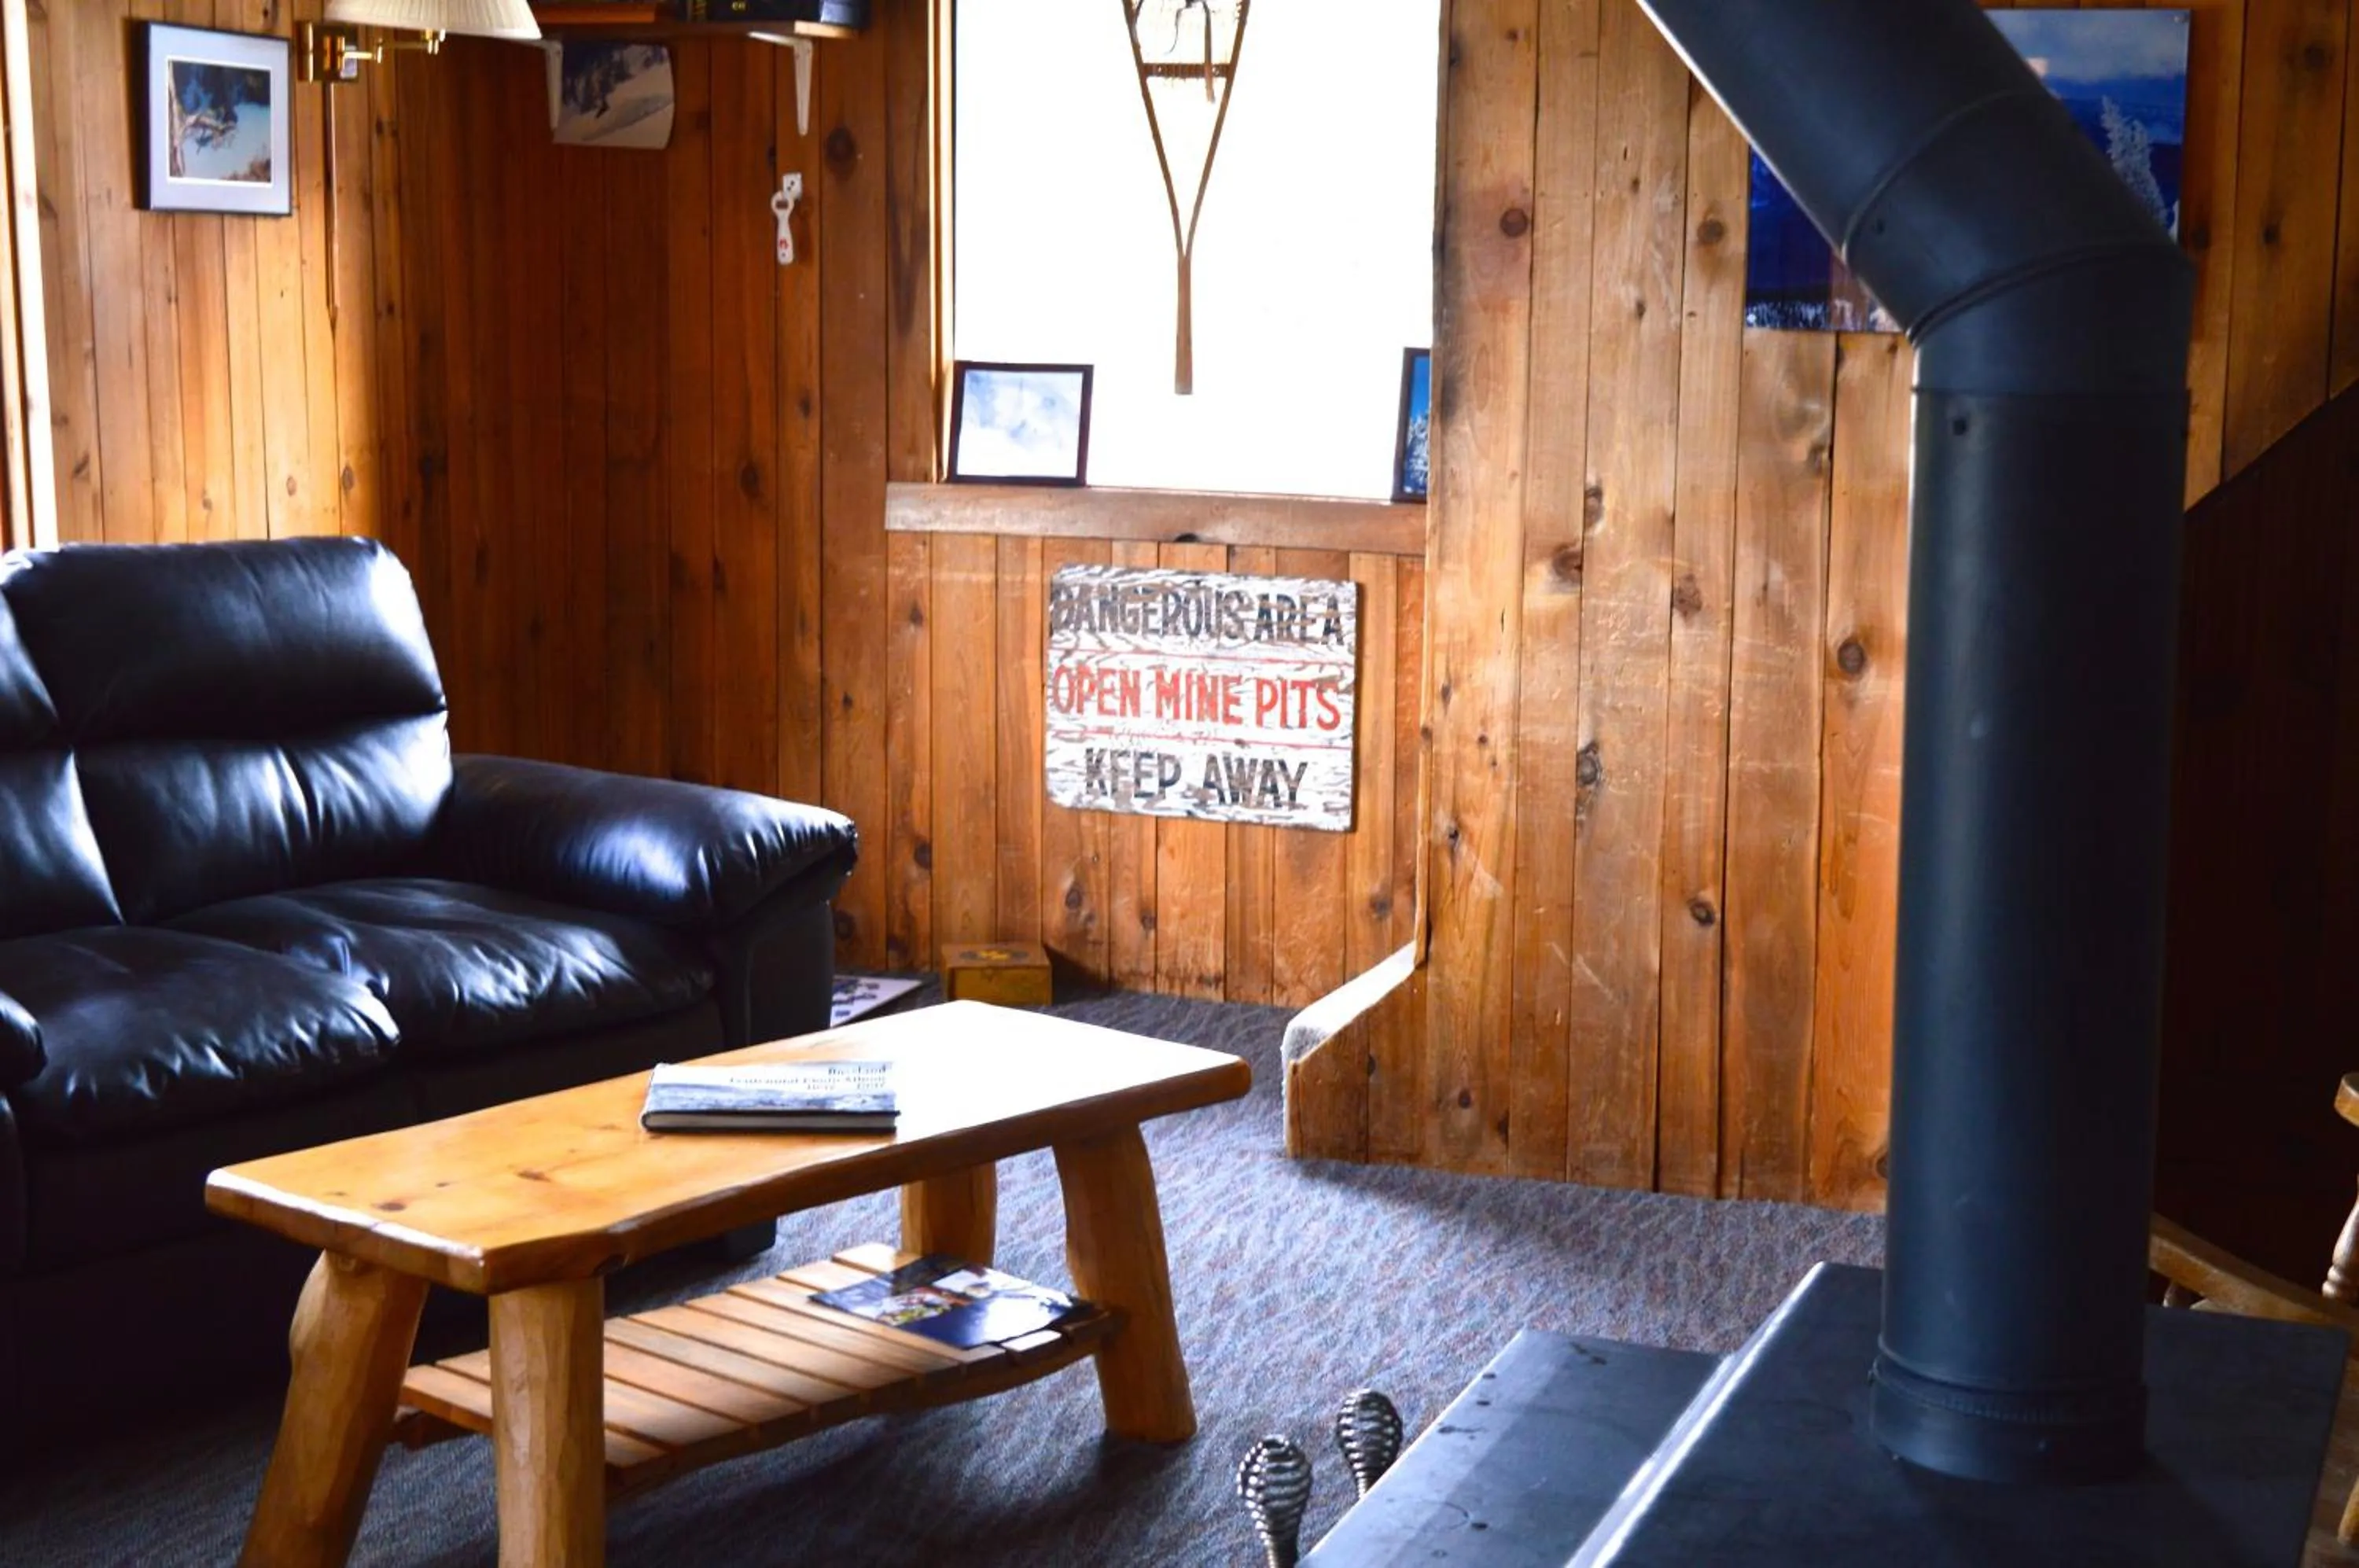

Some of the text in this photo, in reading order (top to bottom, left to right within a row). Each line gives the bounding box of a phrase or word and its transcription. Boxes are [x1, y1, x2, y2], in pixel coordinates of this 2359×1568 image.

[1051, 583, 1345, 646] DANGEROUS AREA
[1052, 664, 1341, 731] OPEN MINE PITS
[1084, 748, 1308, 809] KEEP AWAY
